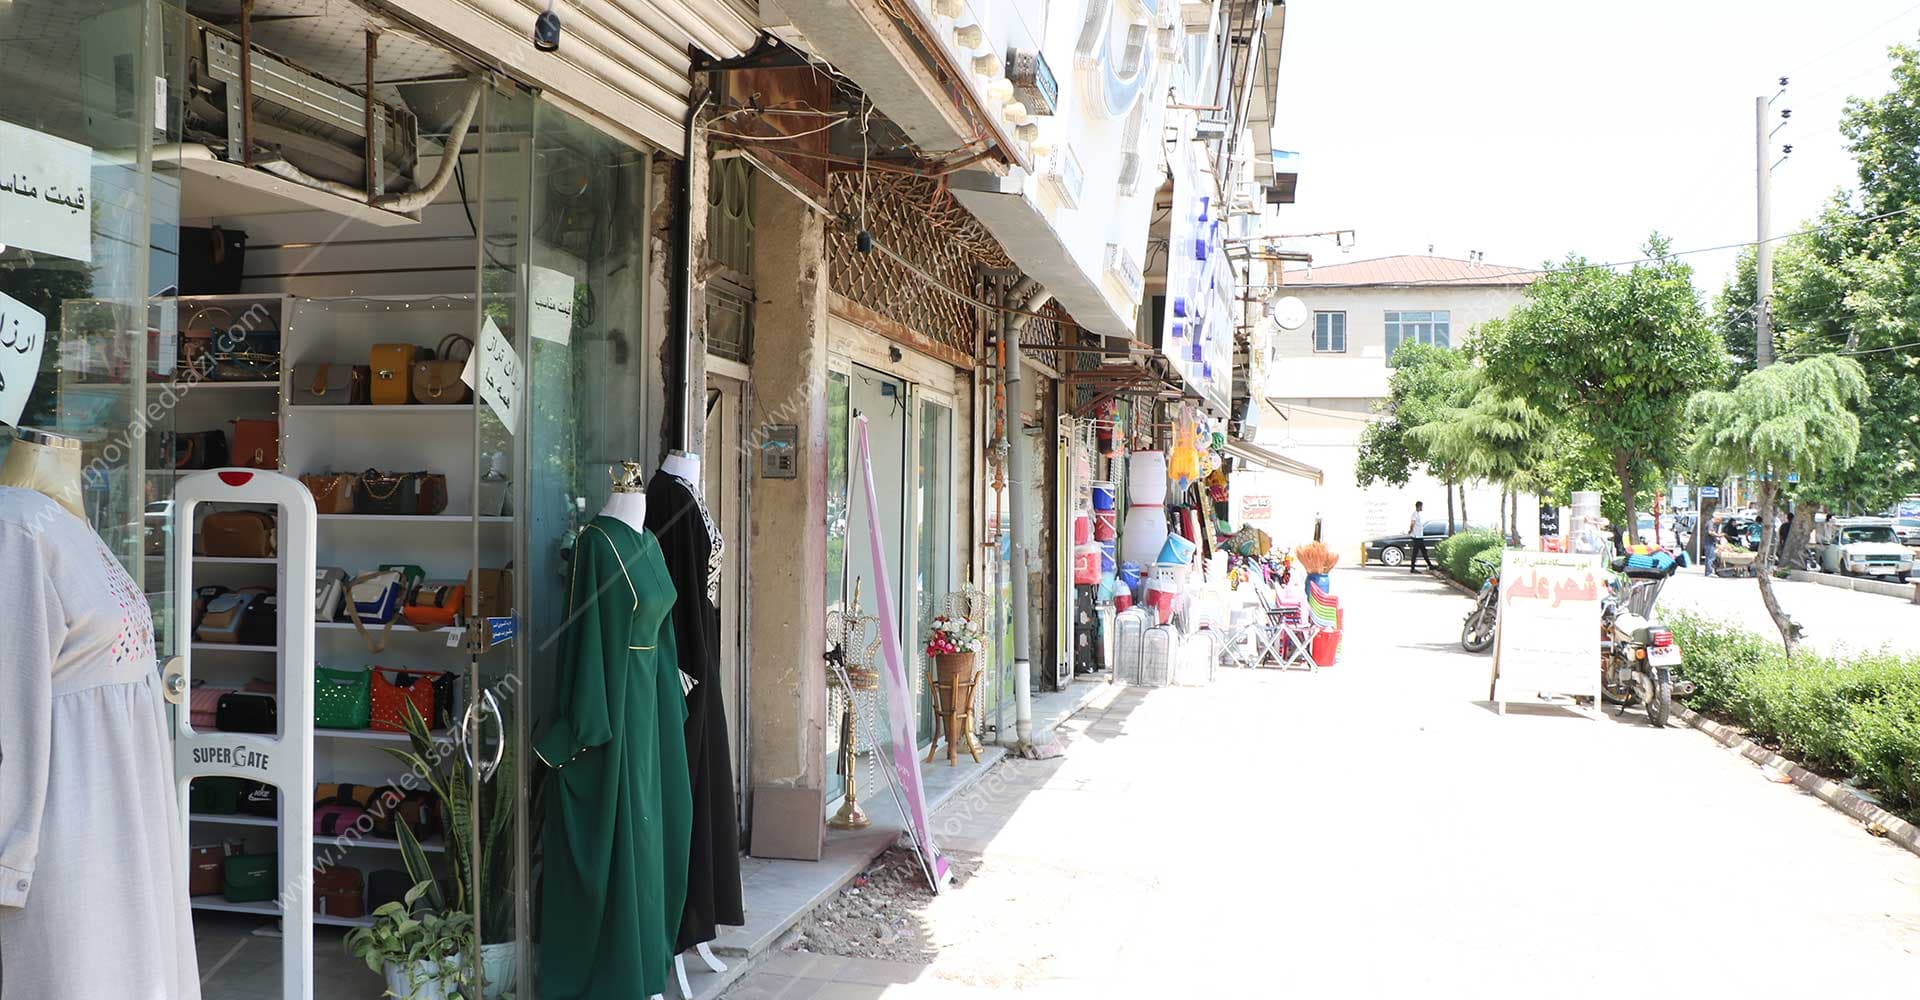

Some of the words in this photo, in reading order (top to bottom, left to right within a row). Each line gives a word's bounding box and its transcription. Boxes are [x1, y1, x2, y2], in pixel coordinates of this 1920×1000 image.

[0, 173, 38, 199] مناس
[44, 185, 86, 214] قیمت
[0, 312, 36, 354] ارزا
[1552, 572, 1598, 608] شهر
